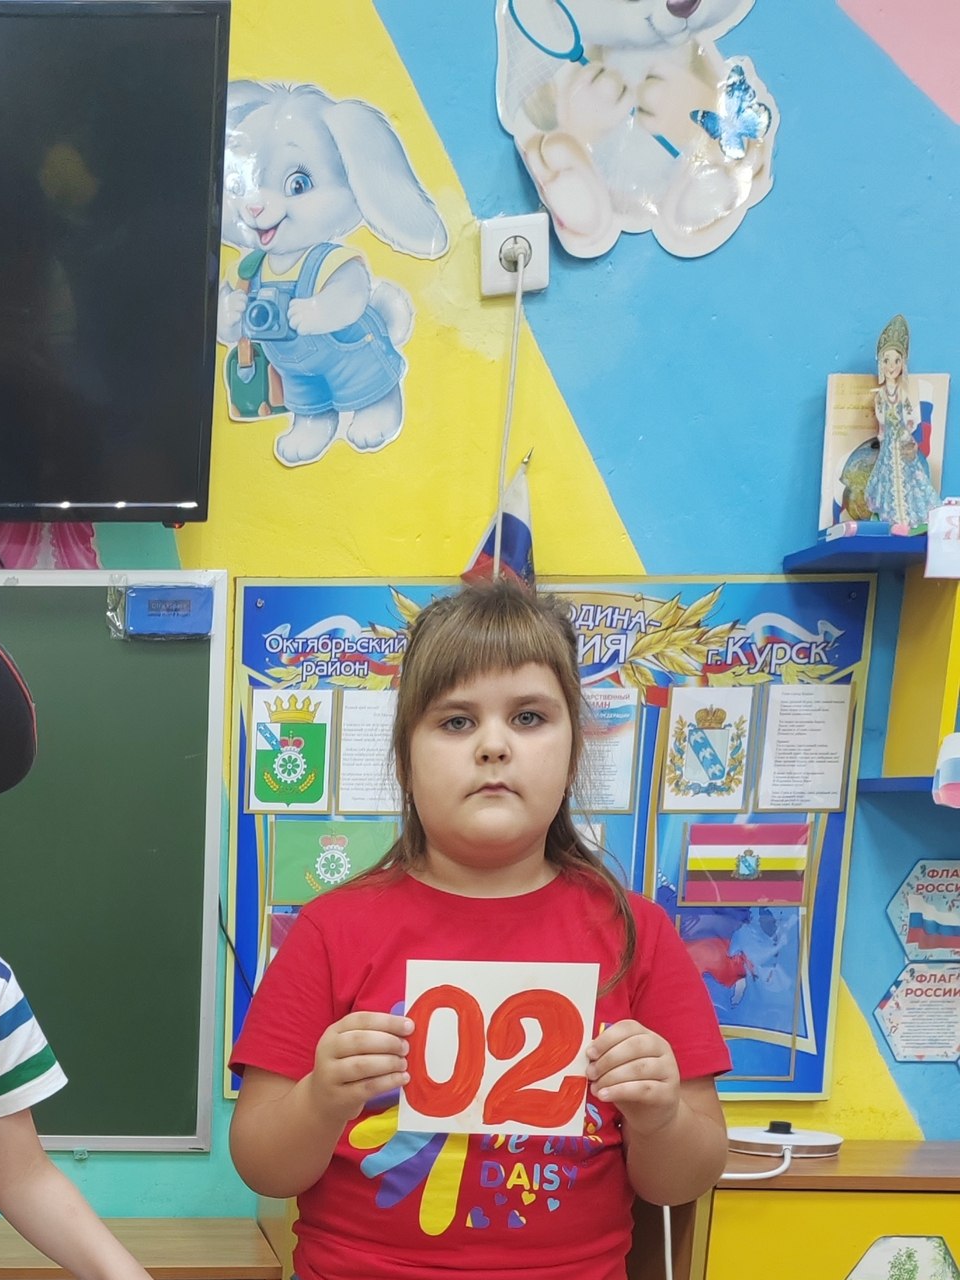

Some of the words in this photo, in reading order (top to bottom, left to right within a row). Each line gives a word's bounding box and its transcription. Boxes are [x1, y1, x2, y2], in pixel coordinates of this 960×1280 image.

[264, 633, 408, 662] Октябрьский
[302, 659, 369, 682] район
[915, 973, 956, 984] ФЛАГ
[402, 984, 588, 1129] 02
[480, 1161, 579, 1191] DAISY
